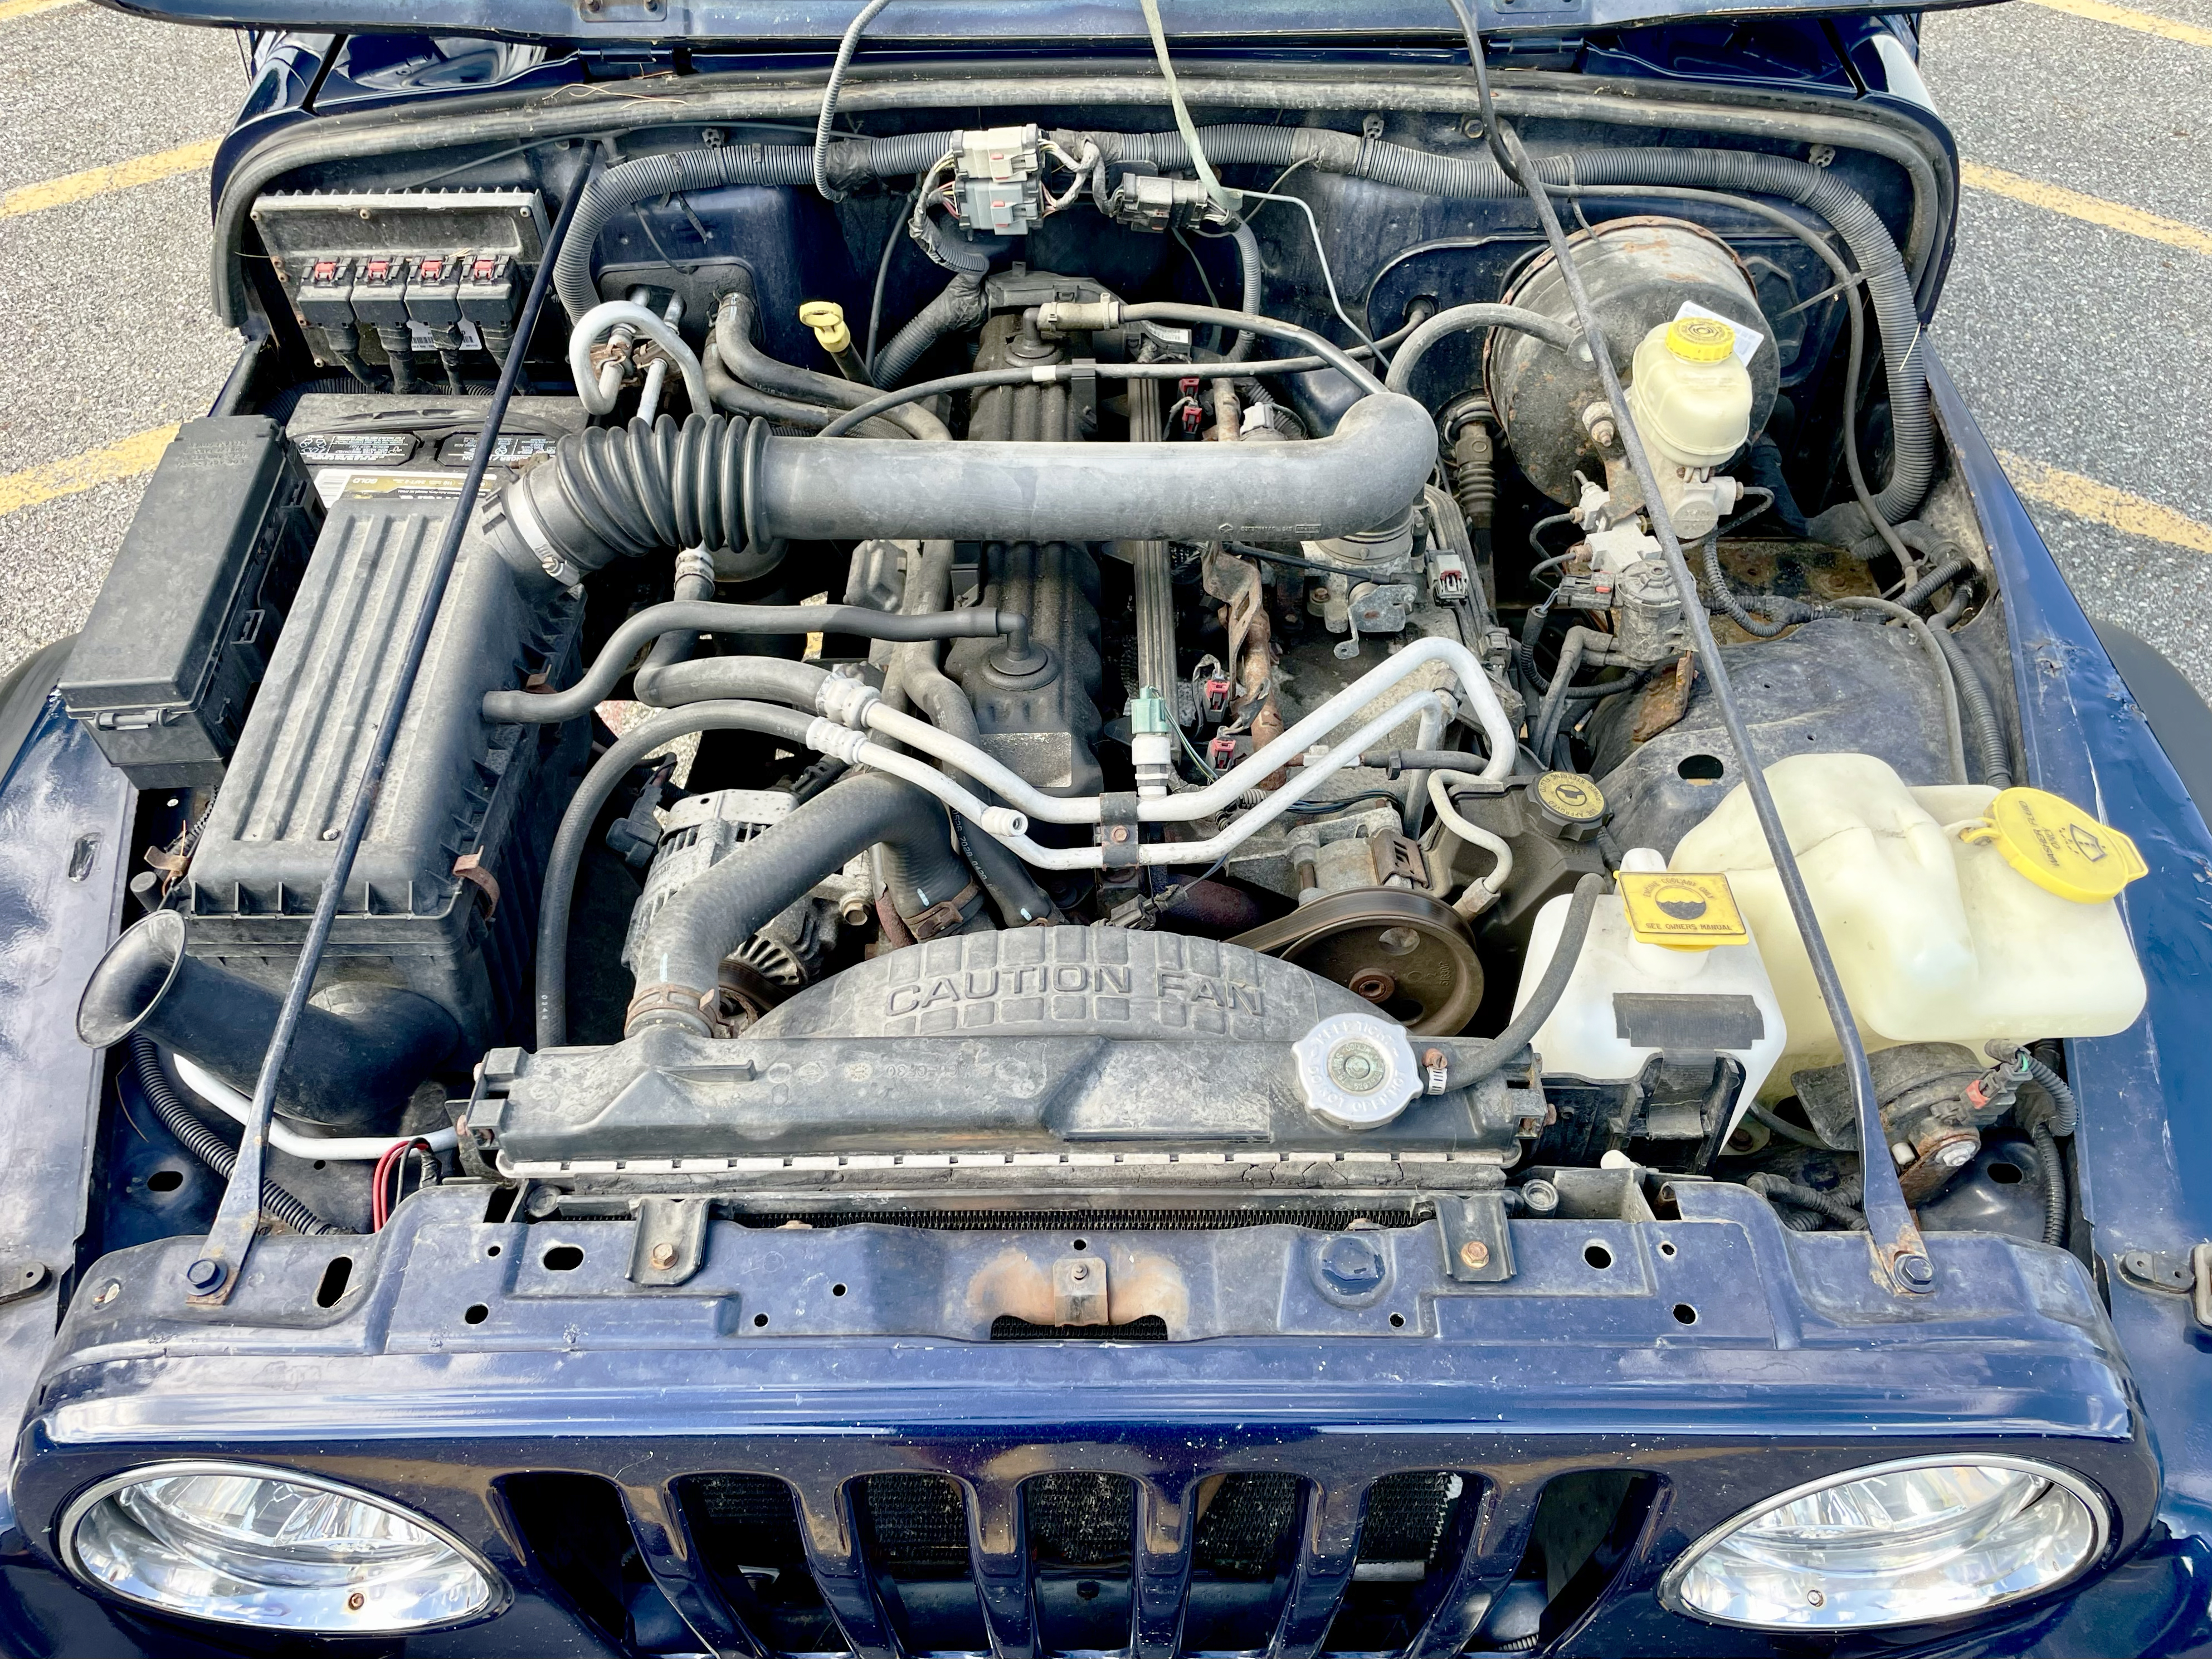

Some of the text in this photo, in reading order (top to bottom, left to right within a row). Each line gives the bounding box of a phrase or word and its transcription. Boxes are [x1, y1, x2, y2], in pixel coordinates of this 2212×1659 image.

[1539, 773, 1602, 801] POWER STEERING FLUID
[1548, 800, 1599, 818] USE APPROVED
[960, 835, 974, 857] 7028
[2018, 800, 2060, 868] WASHER FLUID
[2040, 826, 2061, 850] ONLY
[1643, 877, 1714, 900] ENGINE COOLANT ONLY
[885, 964, 1266, 1018] CAUTION FAN
[1357, 1020, 1393, 1044] TIGHT
[1345, 1043, 1372, 1054] MEXICO
[1308, 1065, 1408, 1113] DO NOT OPEN HOT
